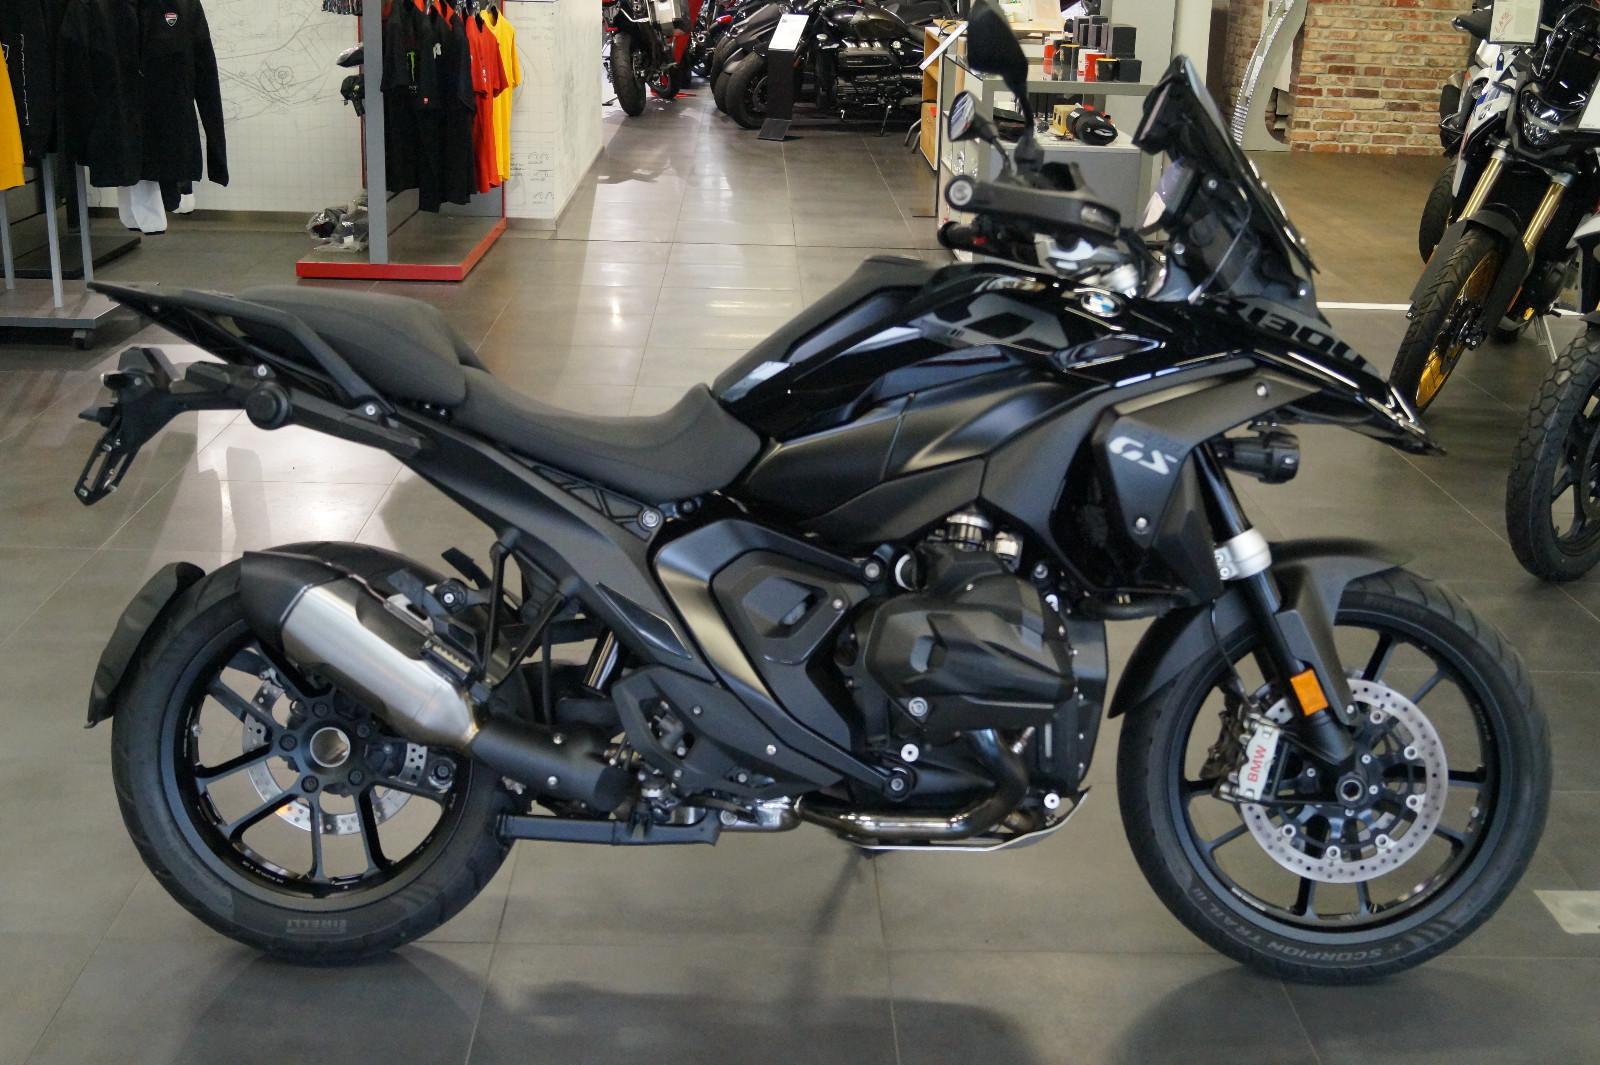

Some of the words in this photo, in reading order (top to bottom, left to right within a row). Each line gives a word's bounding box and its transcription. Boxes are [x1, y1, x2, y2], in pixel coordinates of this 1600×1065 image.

[1109, 436, 1178, 475] GS
[1247, 745, 1267, 783] BMW
[1208, 902, 1263, 945] TRAIL
[1267, 941, 1383, 963] SCORPION
